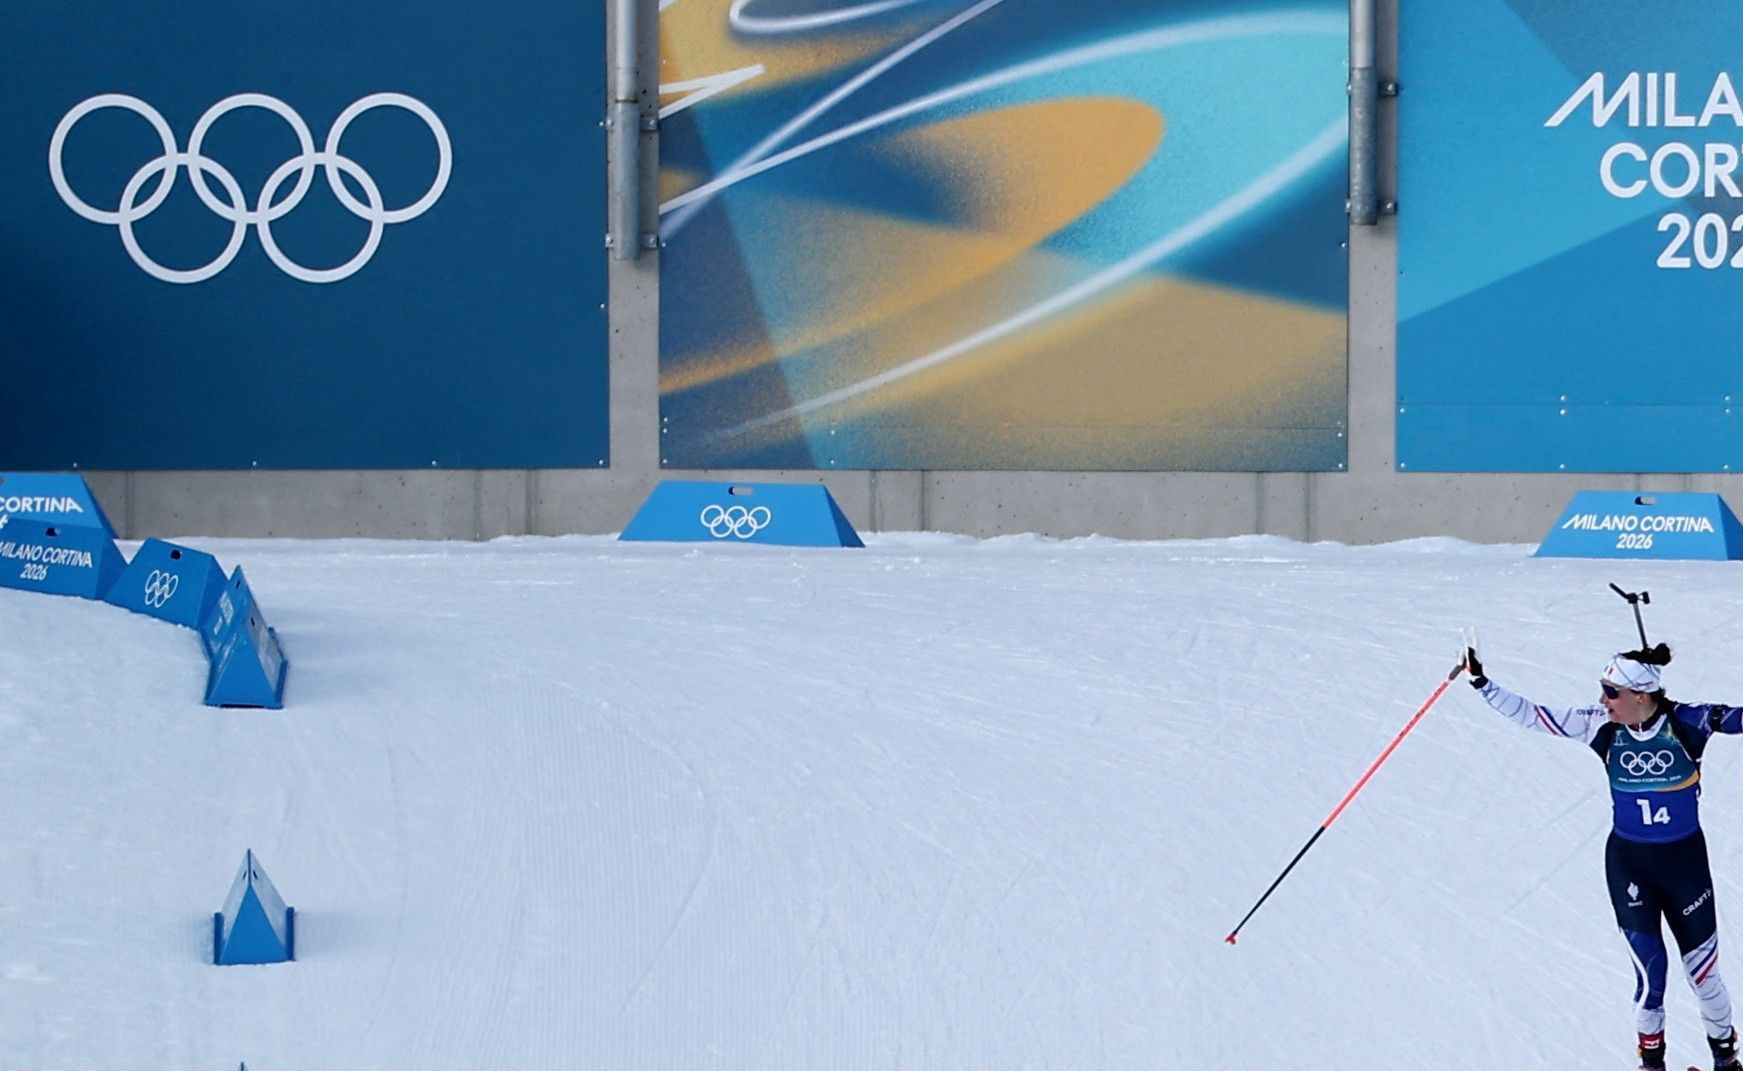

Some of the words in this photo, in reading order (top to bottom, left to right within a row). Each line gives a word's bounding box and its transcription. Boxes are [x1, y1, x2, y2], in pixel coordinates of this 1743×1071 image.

[1562, 514, 1638, 533] MILANO
[1640, 515, 1714, 533] CORTINA
[1616, 533, 1653, 549] 2026
[42, 547, 93, 568] CORTINA
[20, 562, 49, 580] 2026
[1682, 892, 1708, 915] CRAFT
